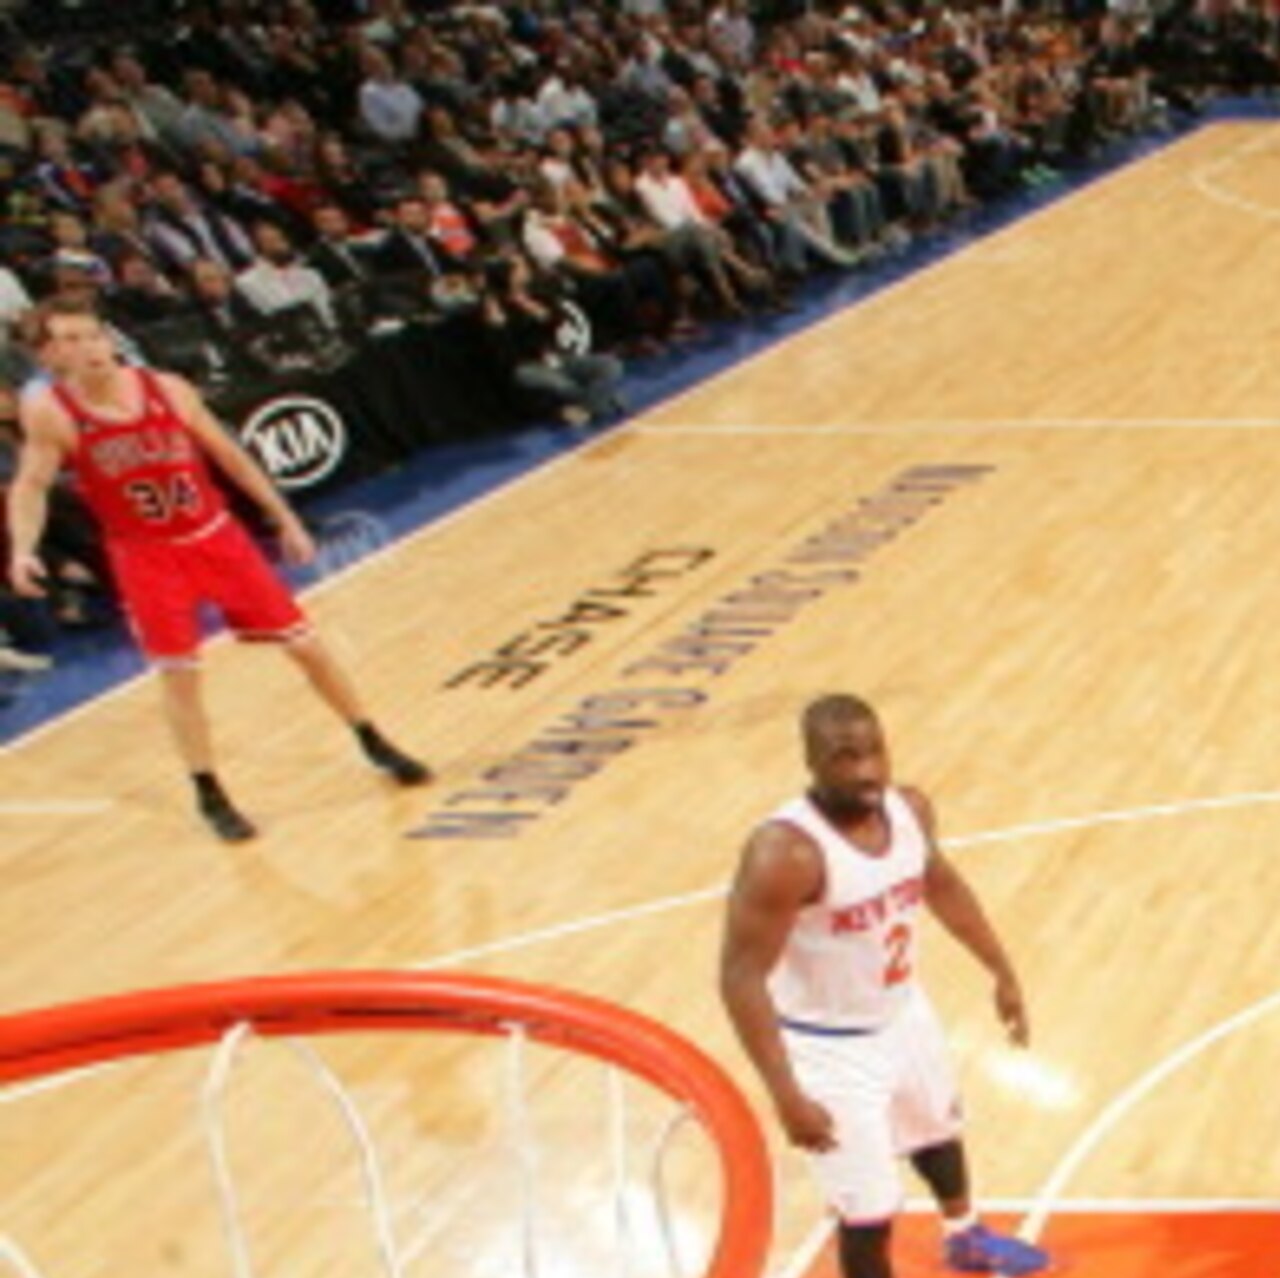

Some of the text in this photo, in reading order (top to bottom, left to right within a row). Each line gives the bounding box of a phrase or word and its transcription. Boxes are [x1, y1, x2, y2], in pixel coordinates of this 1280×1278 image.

[254, 410, 333, 474] KIA
[122, 470, 204, 521] 34
[442, 546, 716, 691] CHASE
[404, 686, 710, 840] GARDEN
[882, 922, 912, 989] 2
